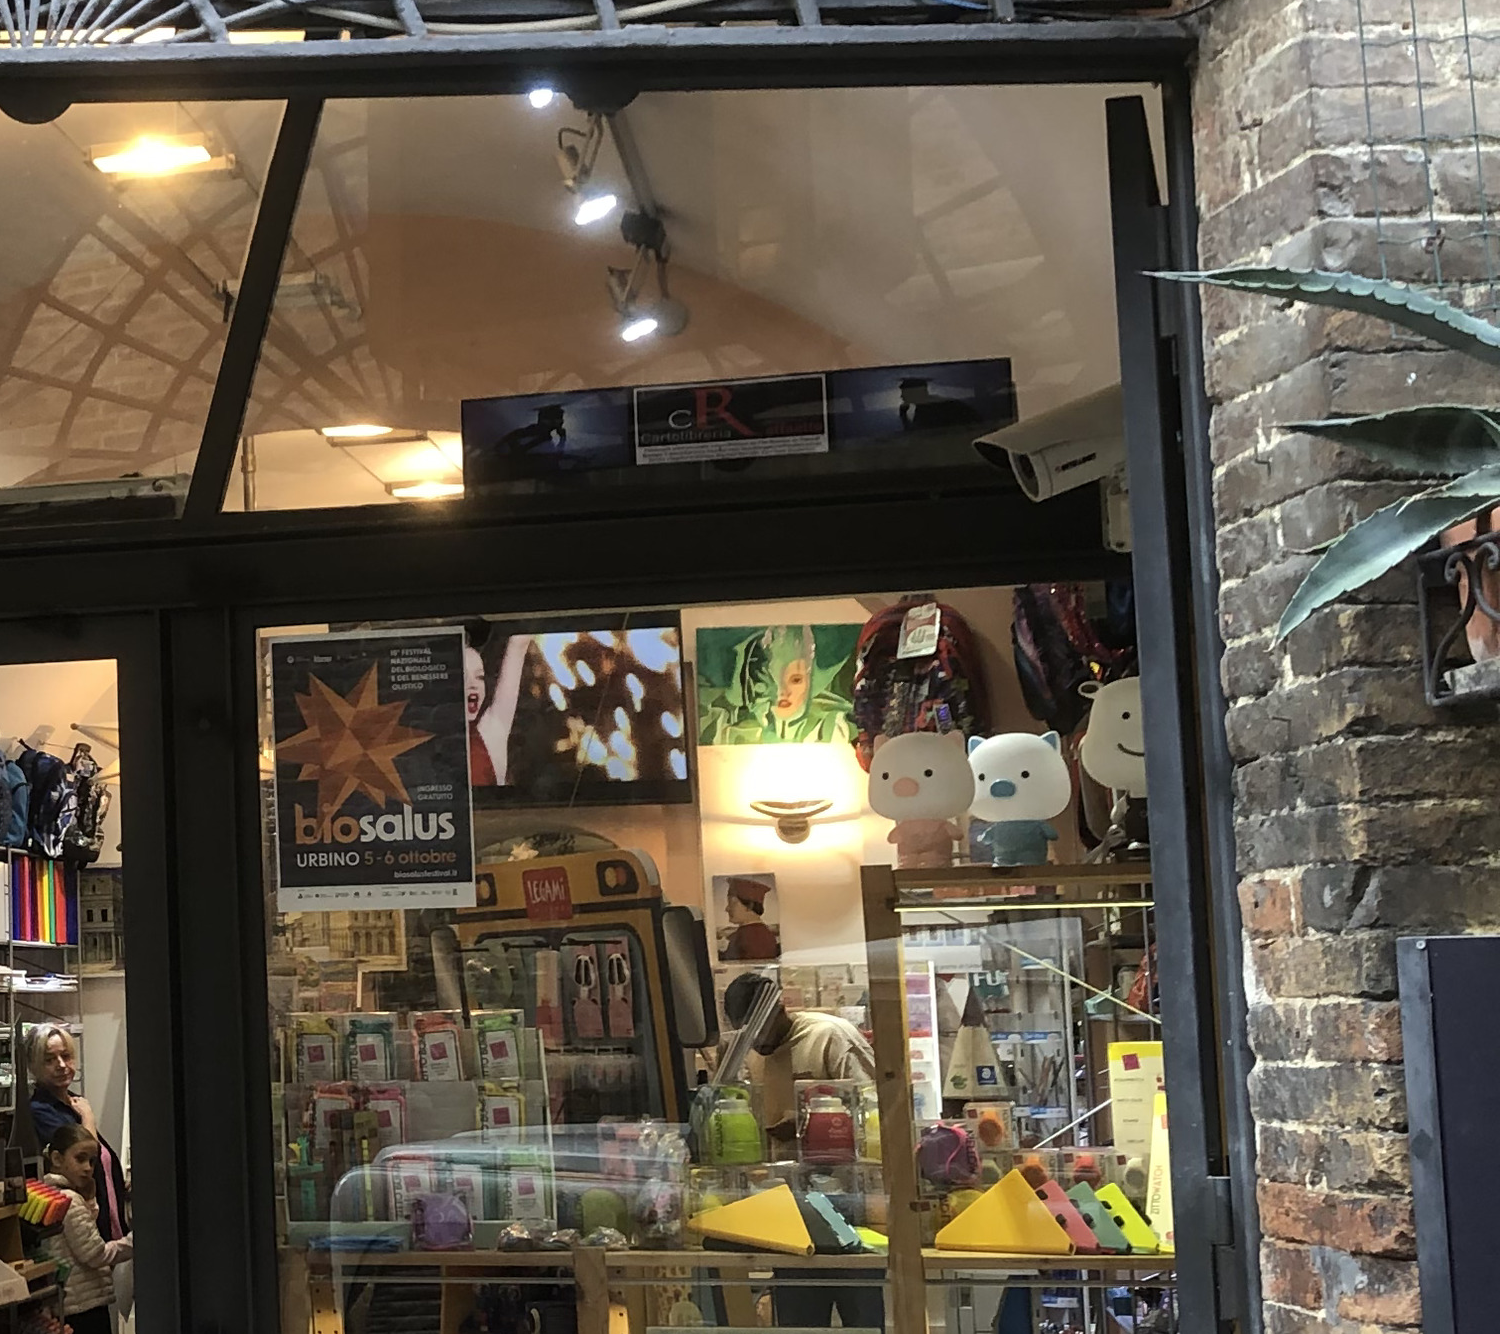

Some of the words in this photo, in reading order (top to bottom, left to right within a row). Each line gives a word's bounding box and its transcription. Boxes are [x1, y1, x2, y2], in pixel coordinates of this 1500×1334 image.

[417, 784, 453, 792] INGRESSO
[417, 793, 453, 801] GRATUITO
[295, 803, 456, 845] biosalus
[297, 851, 360, 868] URBINO
[400, 849, 457, 864] ottobre
